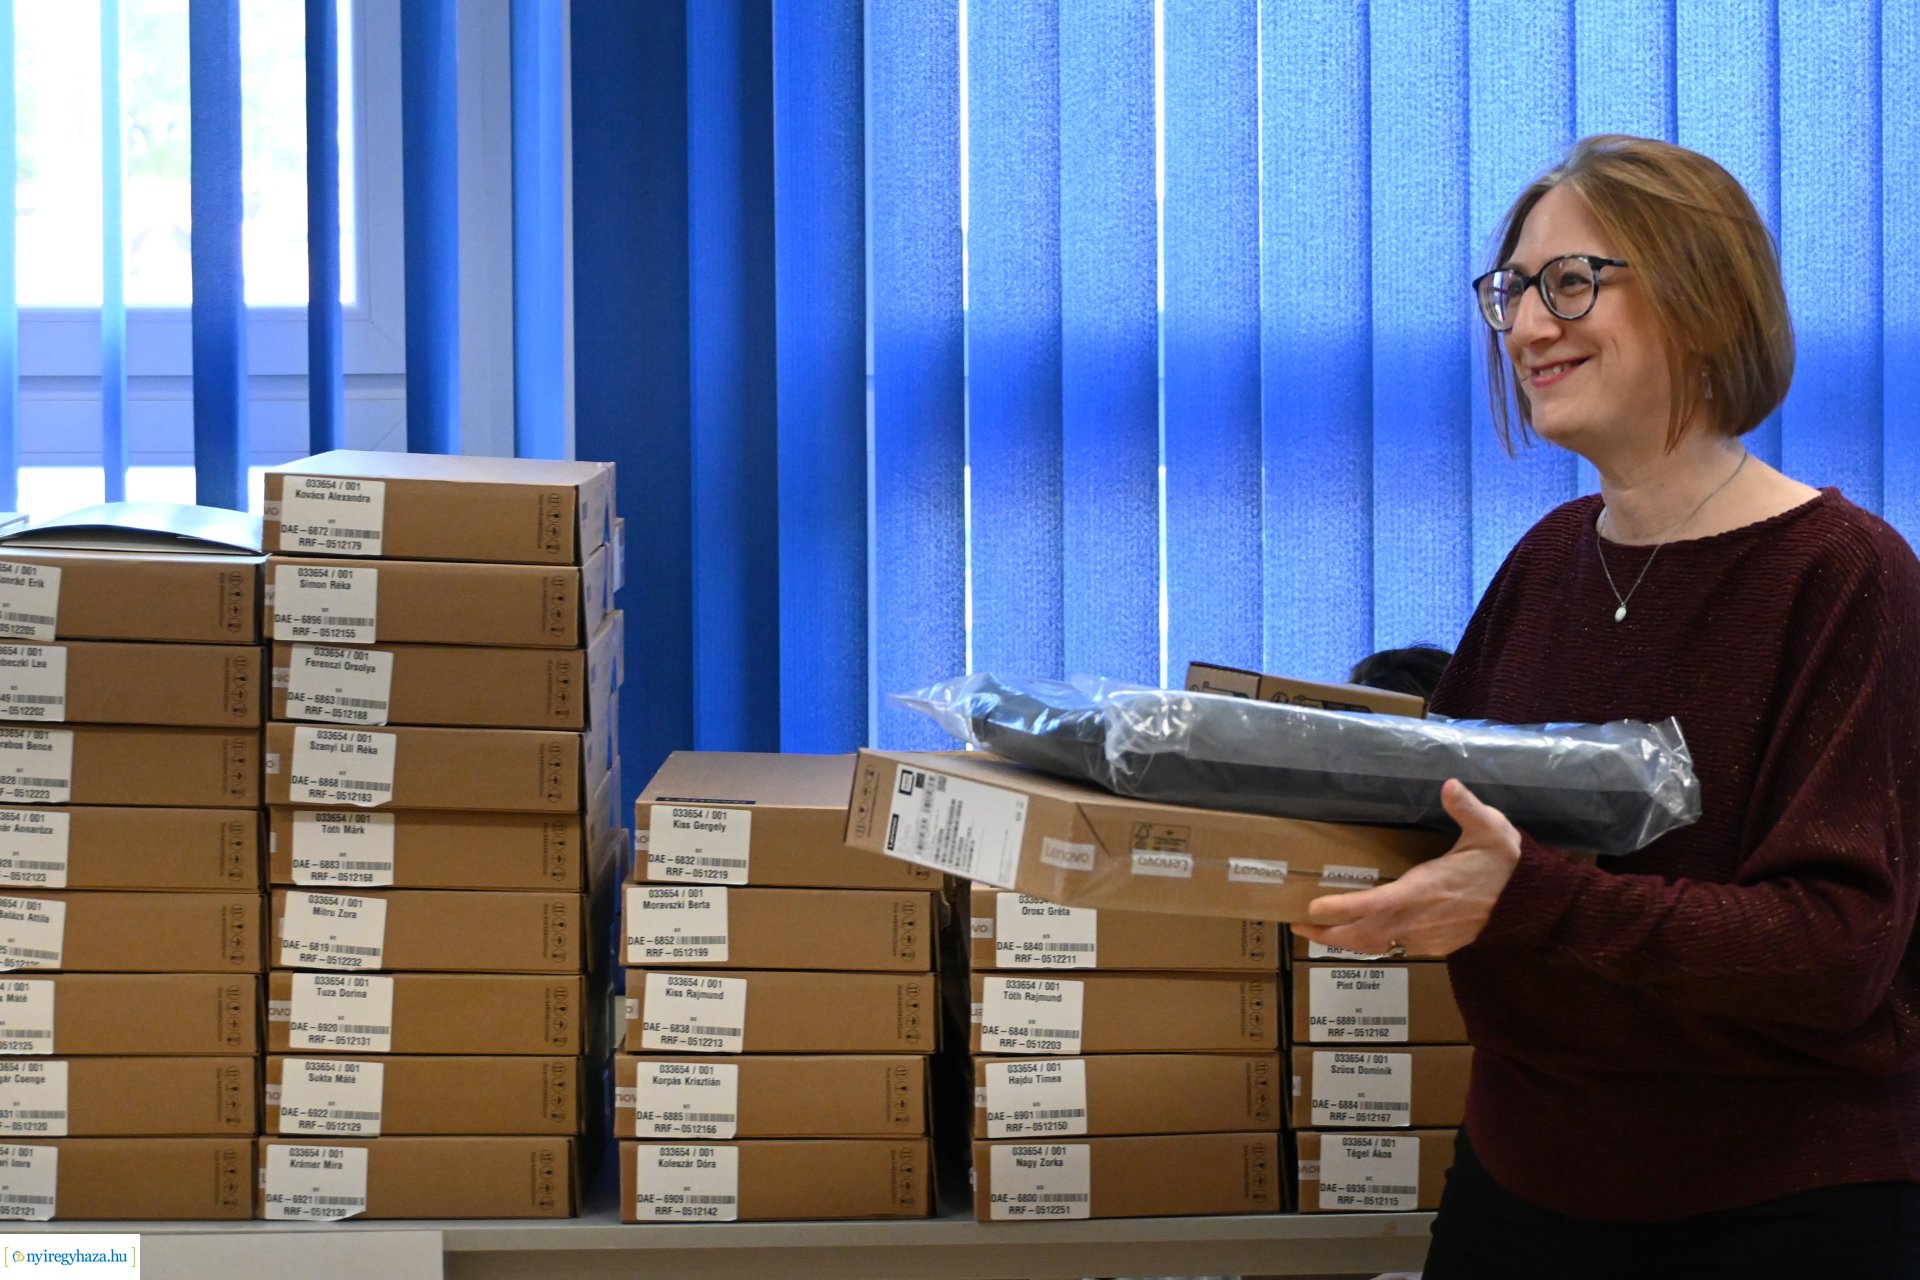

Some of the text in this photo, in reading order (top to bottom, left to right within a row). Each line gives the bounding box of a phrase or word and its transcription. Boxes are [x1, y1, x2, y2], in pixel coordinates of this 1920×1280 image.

[306, 479, 336, 489] 033654
[345, 481, 360, 491] 001
[328, 492, 371, 503] Alexandra
[298, 568, 328, 577] 033654
[338, 569, 352, 578] 001
[300, 579, 351, 590] Simon Réka
[314, 647, 344, 658] 033654
[354, 650, 369, 660] 001
[305, 657, 376, 674] Ferenczi Orsolya
[317, 730, 347, 740] 033654
[357, 733, 372, 743] 001
[357, 744, 378, 755] Réka
[316, 813, 346, 822] 033654
[355, 814, 370, 823] 001
[673, 808, 703, 818] 033654
[712, 810, 726, 820] 001
[322, 824, 340, 833] Tóth
[673, 820, 726, 832] Kiss Gergely
[1045, 842, 1090, 864] Lenovo
[1138, 855, 1188, 871] Lenovo
[649, 889, 679, 898] 033654
[688, 889, 703, 898] 001
[309, 894, 339, 905] 033654
[348, 898, 362, 908] 001
[643, 900, 710, 909] Moravszki Berta
[338, 908, 357, 918] Zora
[1022, 906, 1070, 916] Orosz Gréta
[1331, 969, 1361, 979] 033654
[1370, 970, 1384, 978] 001
[315, 976, 345, 986] 033654
[354, 978, 369, 987] 001
[668, 976, 698, 986] 033654
[707, 979, 722, 988] 001
[1006, 979, 1036, 989] 033654
[1045, 981, 1059, 990] 001
[339, 988, 367, 998] Dorina
[666, 988, 724, 1000] Kiss Rajmund
[1004, 990, 1062, 1002] Tóth Rajmund
[1335, 1053, 1364, 1063] 033654
[1373, 1055, 1388, 1064] 001
[660, 1064, 690, 1074] 033654
[699, 1065, 713, 1074] 001
[1008, 1064, 1037, 1073] 033654
[1046, 1062, 1061, 1072] 001
[1342, 1137, 1372, 1146] 033654
[1381, 1138, 1395, 1147] 001
[660, 1147, 690, 1156] 033654
[699, 1148, 714, 1157] 001
[1346, 1148, 1392, 1159] Tégel Ákos
[324, 1160, 343, 1169] Mira
[697, 1159, 716, 1168] Dóra
[1016, 1158, 1064, 1168] Nagy Zorka
